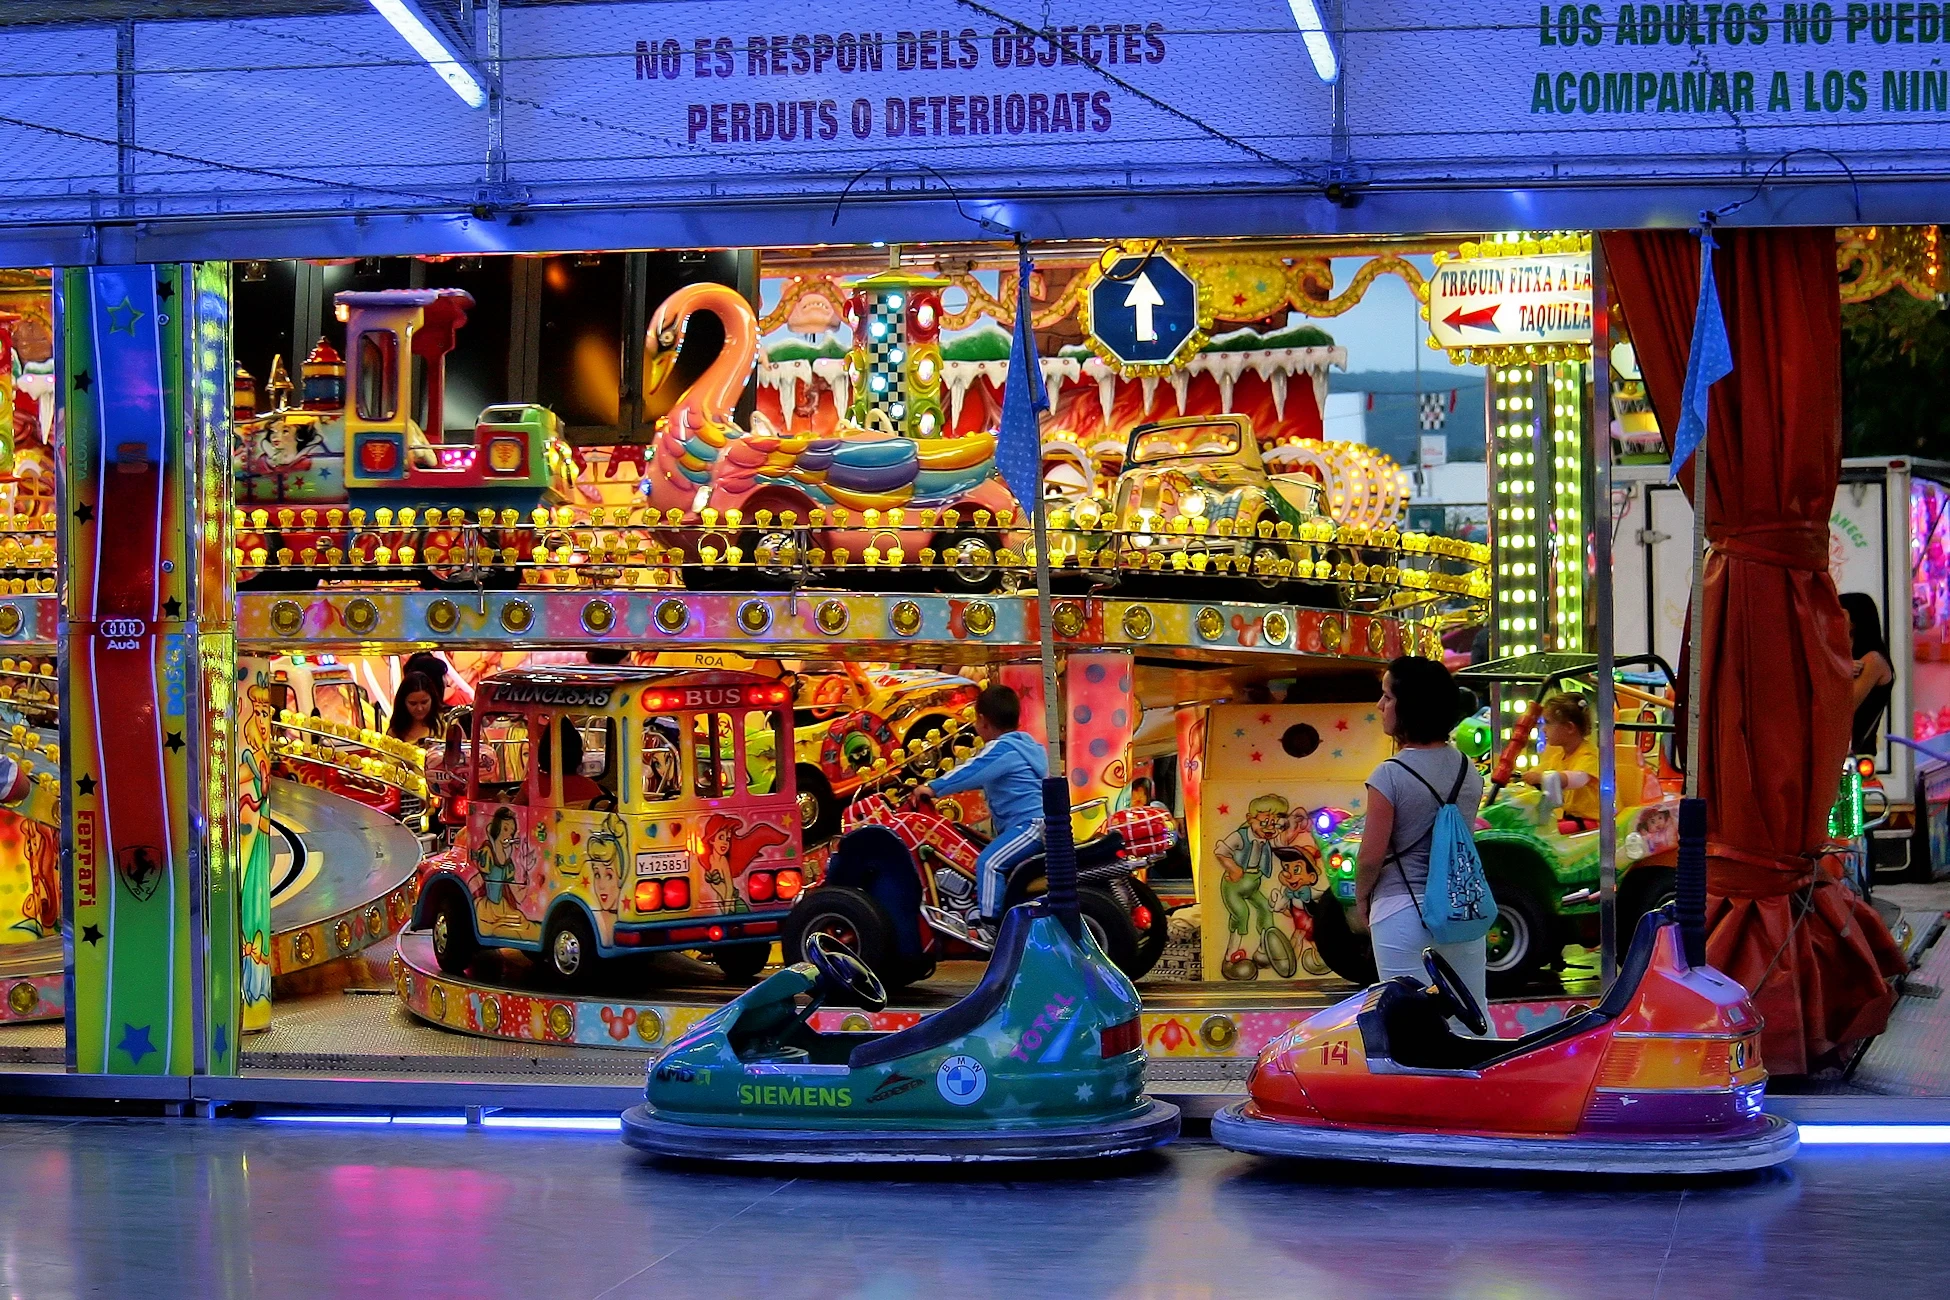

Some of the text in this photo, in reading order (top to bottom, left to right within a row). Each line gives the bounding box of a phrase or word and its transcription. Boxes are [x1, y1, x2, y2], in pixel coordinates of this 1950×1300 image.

[1540, 4, 1602, 46] LOS
[1615, 3, 1768, 46] ADULTOS
[1783, 3, 1832, 44] NO
[636, 22, 1166, 80] NO ES RESPON DELS OBJECTES
[1530, 59, 1754, 114] ACOMPAÑAR
[1767, 71, 1791, 112] A
[1804, 70, 1867, 113] LOS
[687, 91, 1112, 144] PERDUTS O DETERIORATS
[1440, 262, 1593, 298] TREGUIN FITXA A LA
[1518, 302, 1592, 338] TAQUILLA
[107, 640, 140, 650] Audi
[694, 654, 724, 667] ROA
[166, 634, 186, 716] BOSCH
[493, 686, 613, 706] PRINCESAS
[685, 689, 741, 706] BUS
[77, 810, 96, 907] Ferrari
[638, 859, 688, 873] Y-125851
[1010, 993, 1077, 1062] TOTAL
[941, 1057, 983, 1073] BMW
[1321, 1040, 1349, 1065] 14
[739, 1085, 852, 1107] SIEMENS
